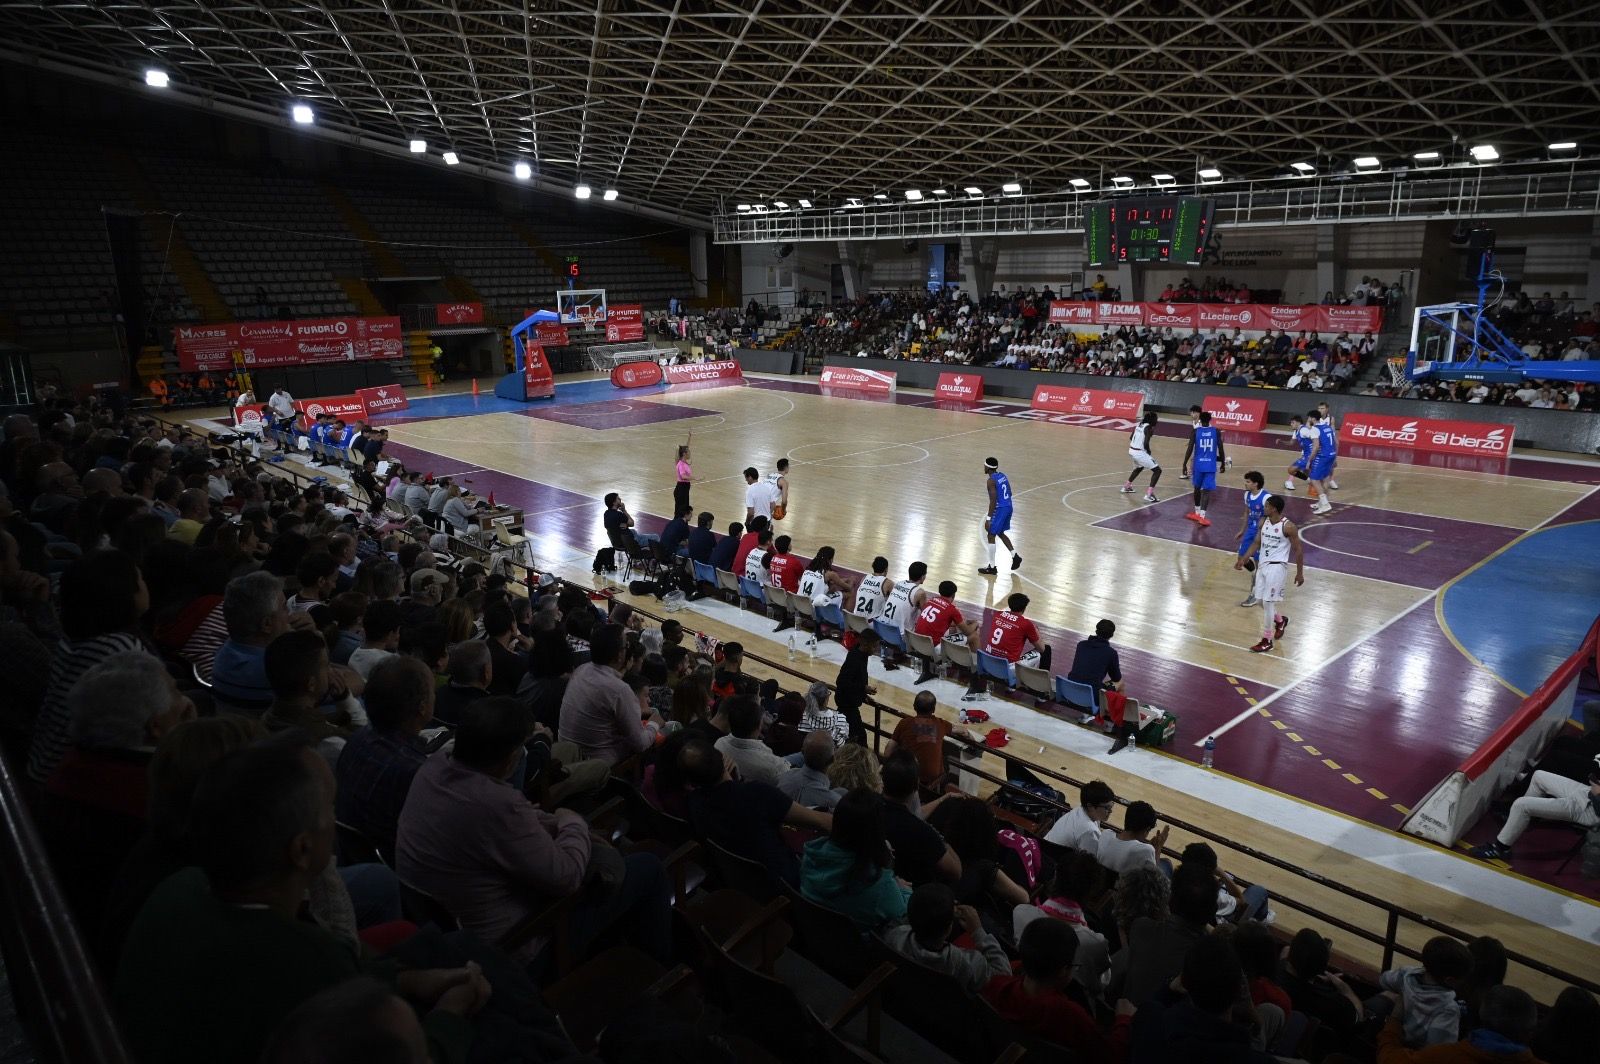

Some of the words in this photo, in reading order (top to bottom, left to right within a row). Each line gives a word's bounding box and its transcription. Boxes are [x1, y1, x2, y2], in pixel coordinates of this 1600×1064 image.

[1128, 209, 1137, 220] 17
[1161, 208, 1172, 220] 11
[1130, 228, 1159, 240] 01:30
[1121, 248, 1126, 258] 5
[1162, 247, 1168, 256] 4
[571, 264, 578, 276] 15
[1113, 304, 1141, 315] IXMA
[669, 362, 735, 374] MARTINAUTO
[691, 371, 719, 380] IVECO
[1326, 433, 1333, 446] 7
[1352, 425, 1367, 436] el
[1367, 426, 1417, 442] bierzo
[1200, 438, 1213, 452] 44
[1432, 433, 1448, 444] el
[1449, 433, 1504, 450] bierzo
[1002, 484, 1009, 500] 2
[771, 573, 782, 588] 15
[803, 580, 814, 596] 14
[857, 596, 873, 614] 24
[884, 602, 896, 619] 21
[921, 605, 941, 623] 45
[992, 628, 1003, 645] 9
